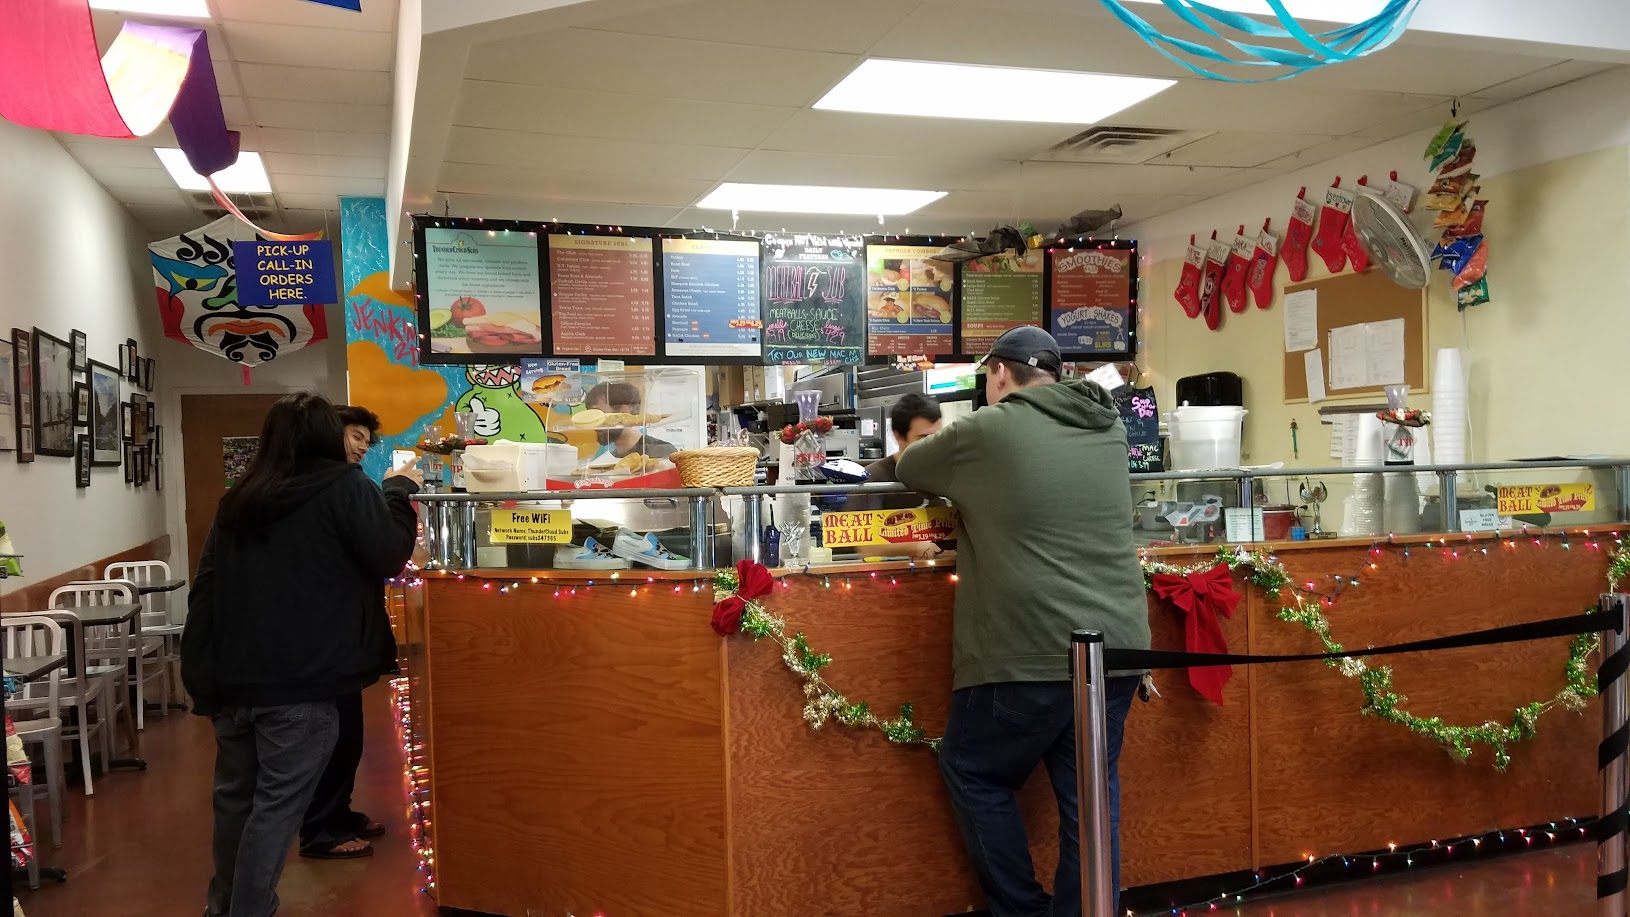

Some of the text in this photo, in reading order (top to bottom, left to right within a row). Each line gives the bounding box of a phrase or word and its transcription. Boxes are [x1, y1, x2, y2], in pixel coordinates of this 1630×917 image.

[574, 239, 612, 247] SIGNATURE
[794, 235, 809, 246] NOT
[257, 245, 309, 256] PICK-UP
[257, 259, 313, 271] CALL-IN
[1058, 255, 1121, 271] SMOOTHIES
[260, 274, 313, 285] ORDERS
[765, 265, 808, 299] MEATBALL
[821, 265, 846, 299] SUB
[269, 288, 307, 300] HERE.
[809, 307, 839, 321] SAUCE
[1061, 309, 1120, 324] YOGURT SHAKES
[789, 319, 820, 332] CHEESE
[805, 348, 827, 359] NEW
[829, 349, 846, 360] MAC
[525, 367, 544, 375] Serving
[1131, 396, 1151, 410] Soup
[1138, 407, 1154, 418] Day
[1498, 486, 1533, 499] MEAT
[1499, 499, 1532, 513] BALL
[512, 512, 551, 524] Free WiFi
[823, 513, 873, 528] MEAT
[879, 525, 909, 538] Limited
[911, 520, 933, 533] Time
[825, 528, 873, 544] BALL
